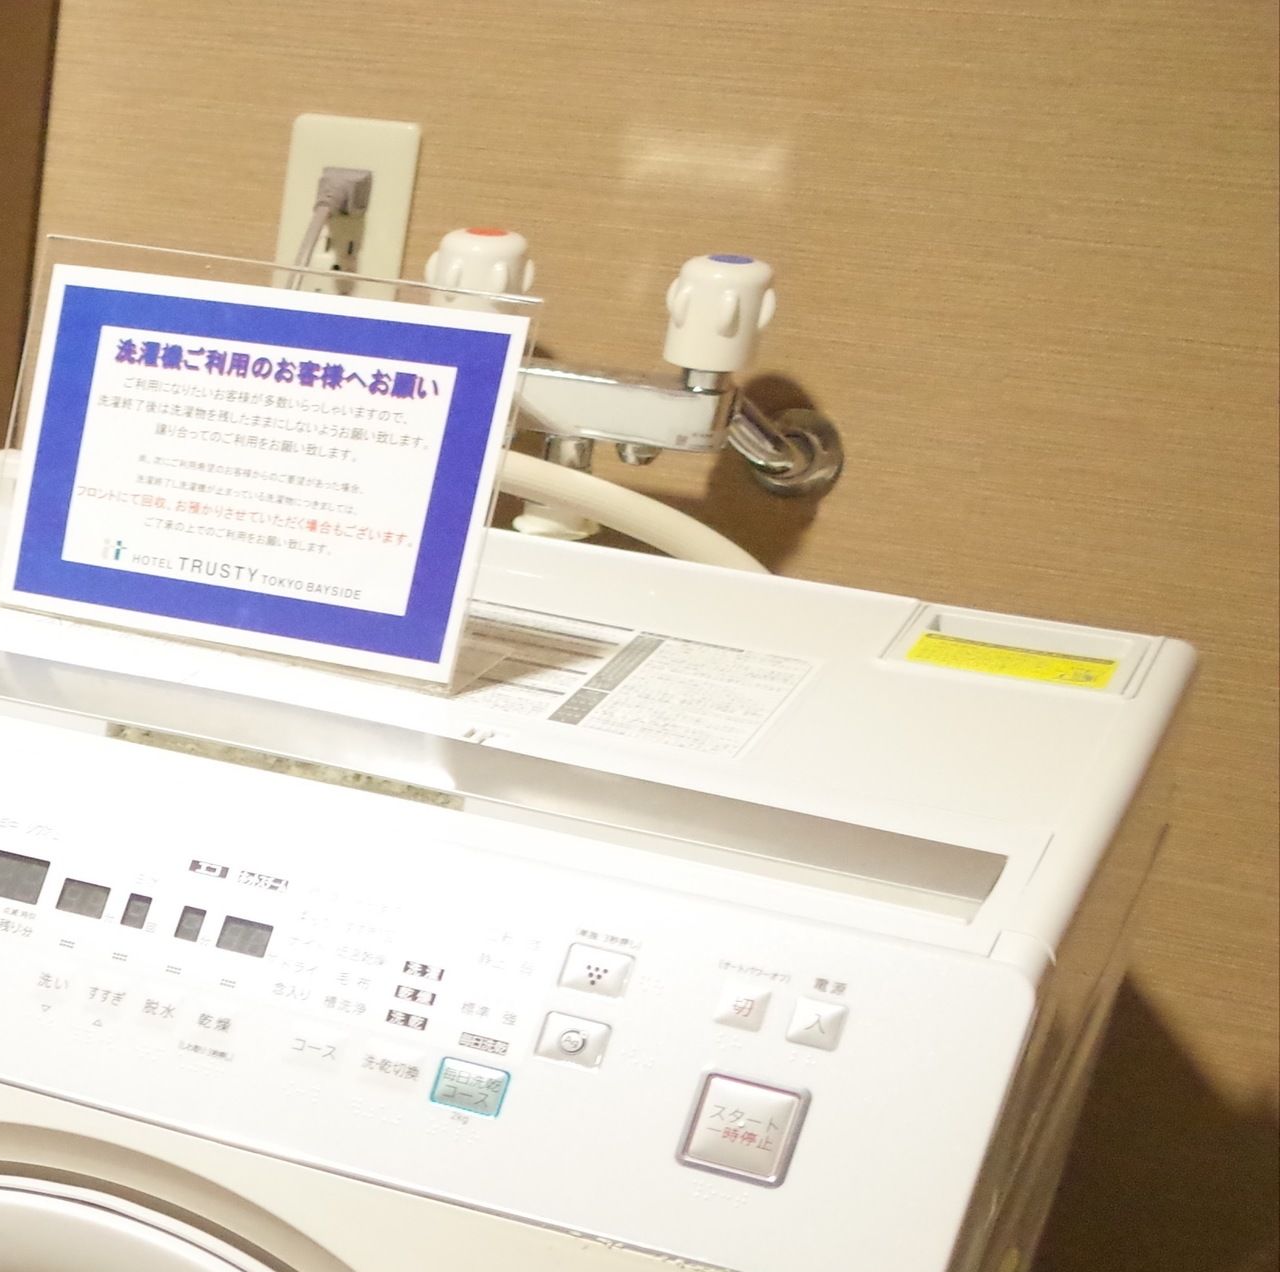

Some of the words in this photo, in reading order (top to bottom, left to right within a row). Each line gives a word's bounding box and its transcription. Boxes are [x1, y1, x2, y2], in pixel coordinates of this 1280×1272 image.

[114, 338, 440, 400] 洗濯機ご利用のお客様へお願い
[123, 376, 409, 425] ご利用になりたいお客様が多数いらっしゃいますので、
[96, 393, 430, 451] 洗濯終了後は洗濯物を残したままにしないようお願い致します。
[154, 422, 358, 462] 譲り合ってのご利用をお願い致します。
[77, 485, 413, 548] フロントにて回収、お預かりさせていただく場合もございます。
[143, 516, 333, 557] ご了承の上でのご利用をお願い致します。
[132, 553, 173, 570] HOTEL
[178, 556, 259, 582] TRUSTY
[261, 574, 303, 592] TOKYO
[306, 581, 363, 601] BAYSIDE
[37, 971, 72, 991] 洗い
[813, 977, 849, 996] 電源
[87, 986, 127, 1007] すすぎ
[142, 998, 177, 1019] 脱水
[732, 998, 754, 1018] 切
[197, 1012, 233, 1034] 乾燥
[803, 1013, 826, 1035] 入
[291, 1037, 337, 1061] コース
[442, 1067, 503, 1094] 毎日洗乾
[442, 1085, 490, 1109] コース
[709, 1104, 780, 1132] スタート
[706, 1125, 774, 1152] 一時停止
